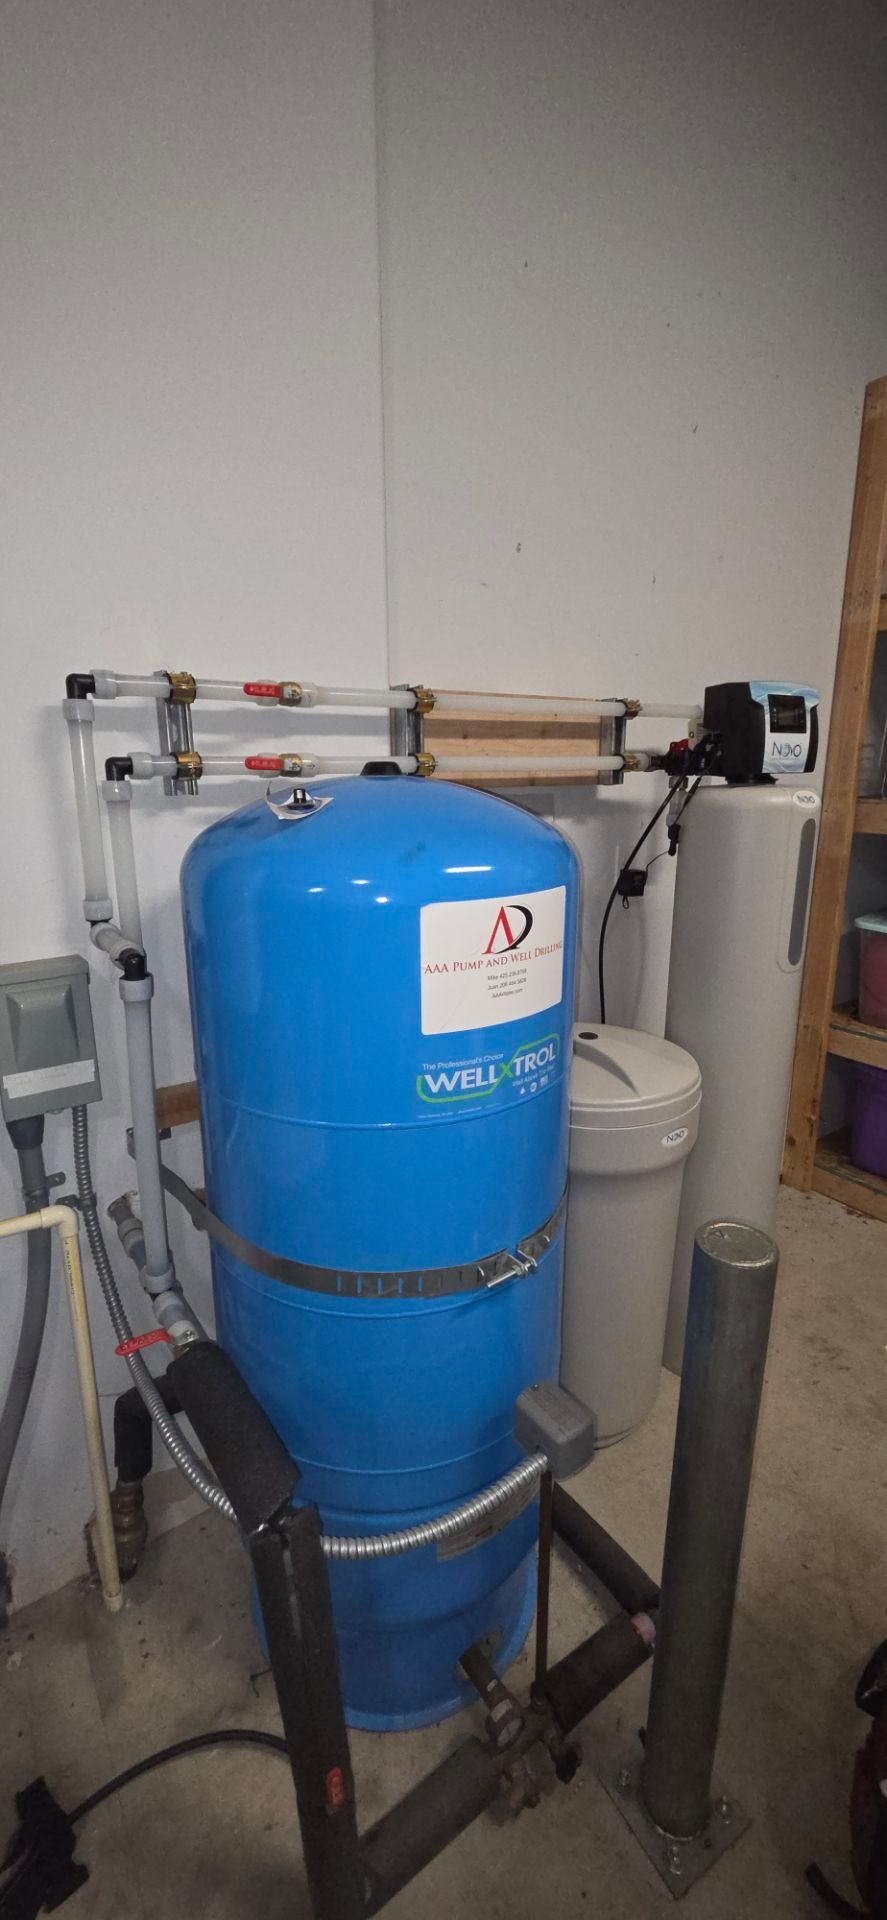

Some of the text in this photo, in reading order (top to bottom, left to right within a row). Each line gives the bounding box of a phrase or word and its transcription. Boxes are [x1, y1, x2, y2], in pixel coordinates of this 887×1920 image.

[424, 940, 563, 975] AAA PUMP AND WELL DRILLING
[422, 1063, 437, 1071] The
[438, 1057, 482, 1069] Professional's
